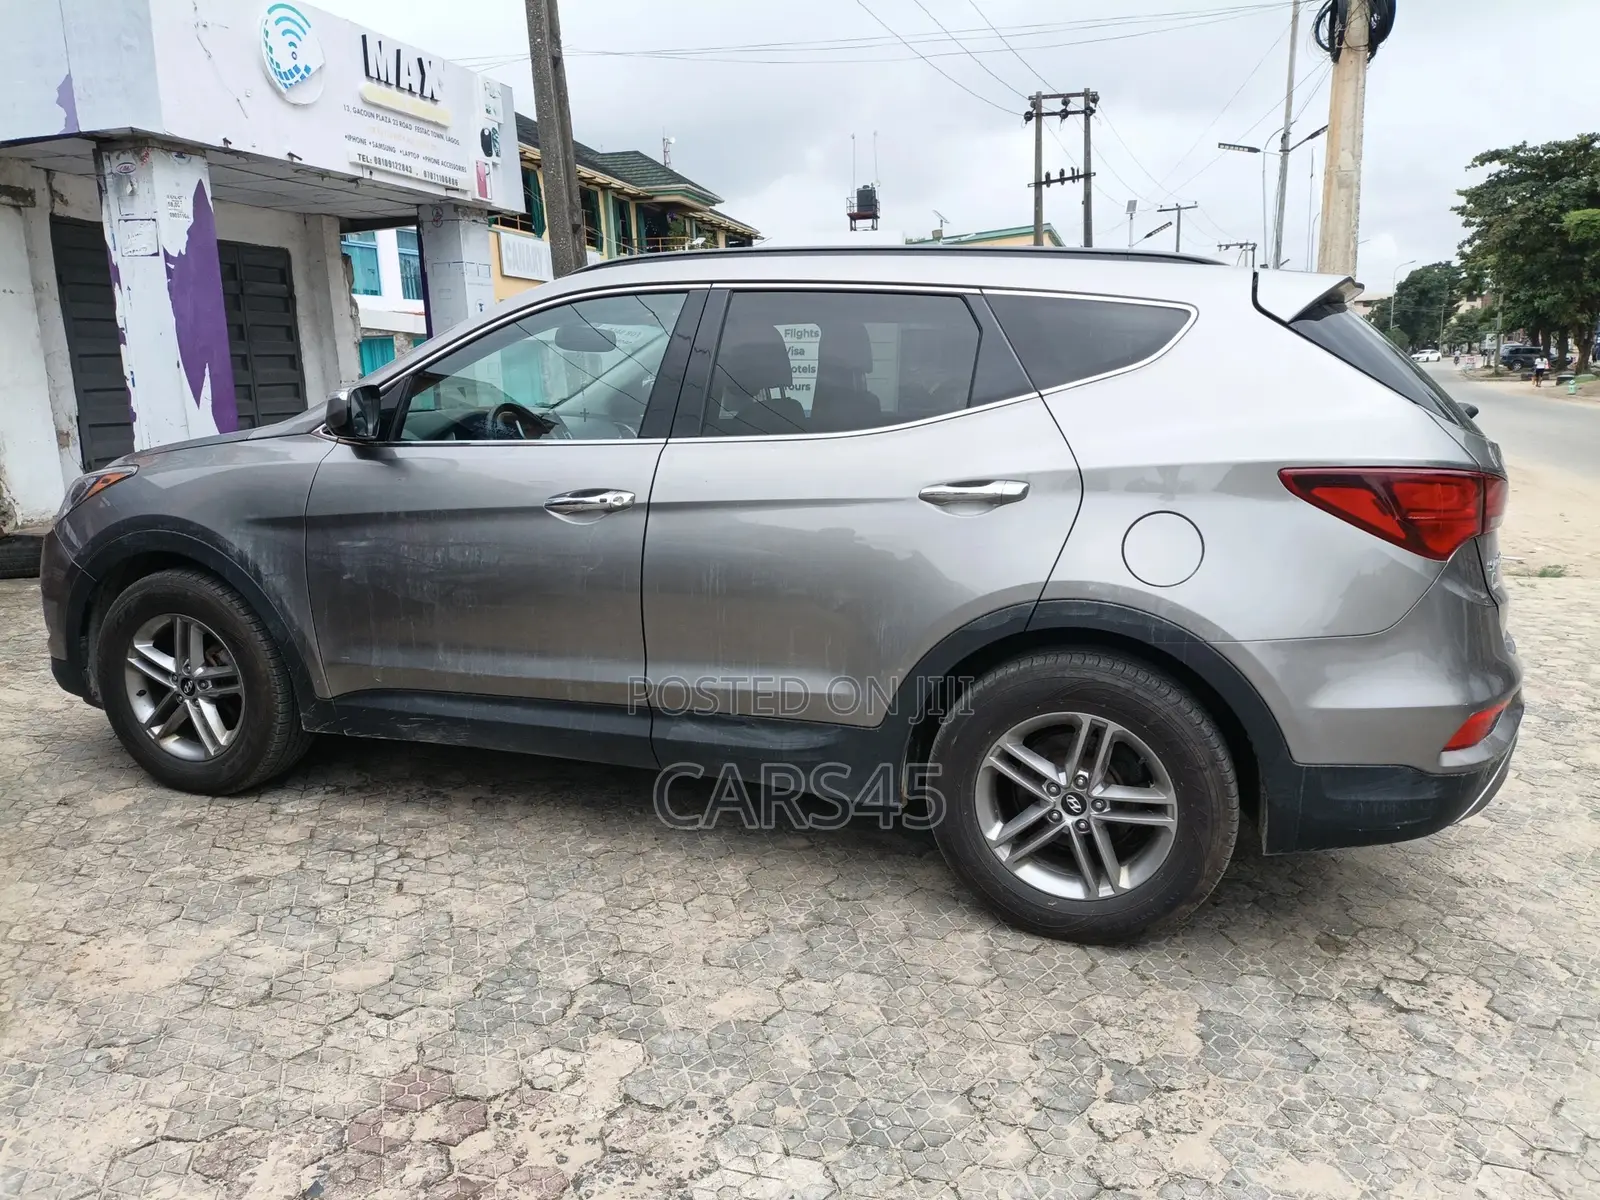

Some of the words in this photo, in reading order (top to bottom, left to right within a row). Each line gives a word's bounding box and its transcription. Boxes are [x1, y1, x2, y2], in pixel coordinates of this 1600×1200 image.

[361, 34, 445, 102] MAX
[375, 113, 392, 124] PLAZA
[398, 120, 413, 131] ROAD
[414, 125, 431, 137] FESTAC
[357, 153, 373, 164] TEL:
[440, 160, 467, 173] ACCESSORIES
[784, 328, 820, 339] Flights
[791, 364, 816, 374] otels
